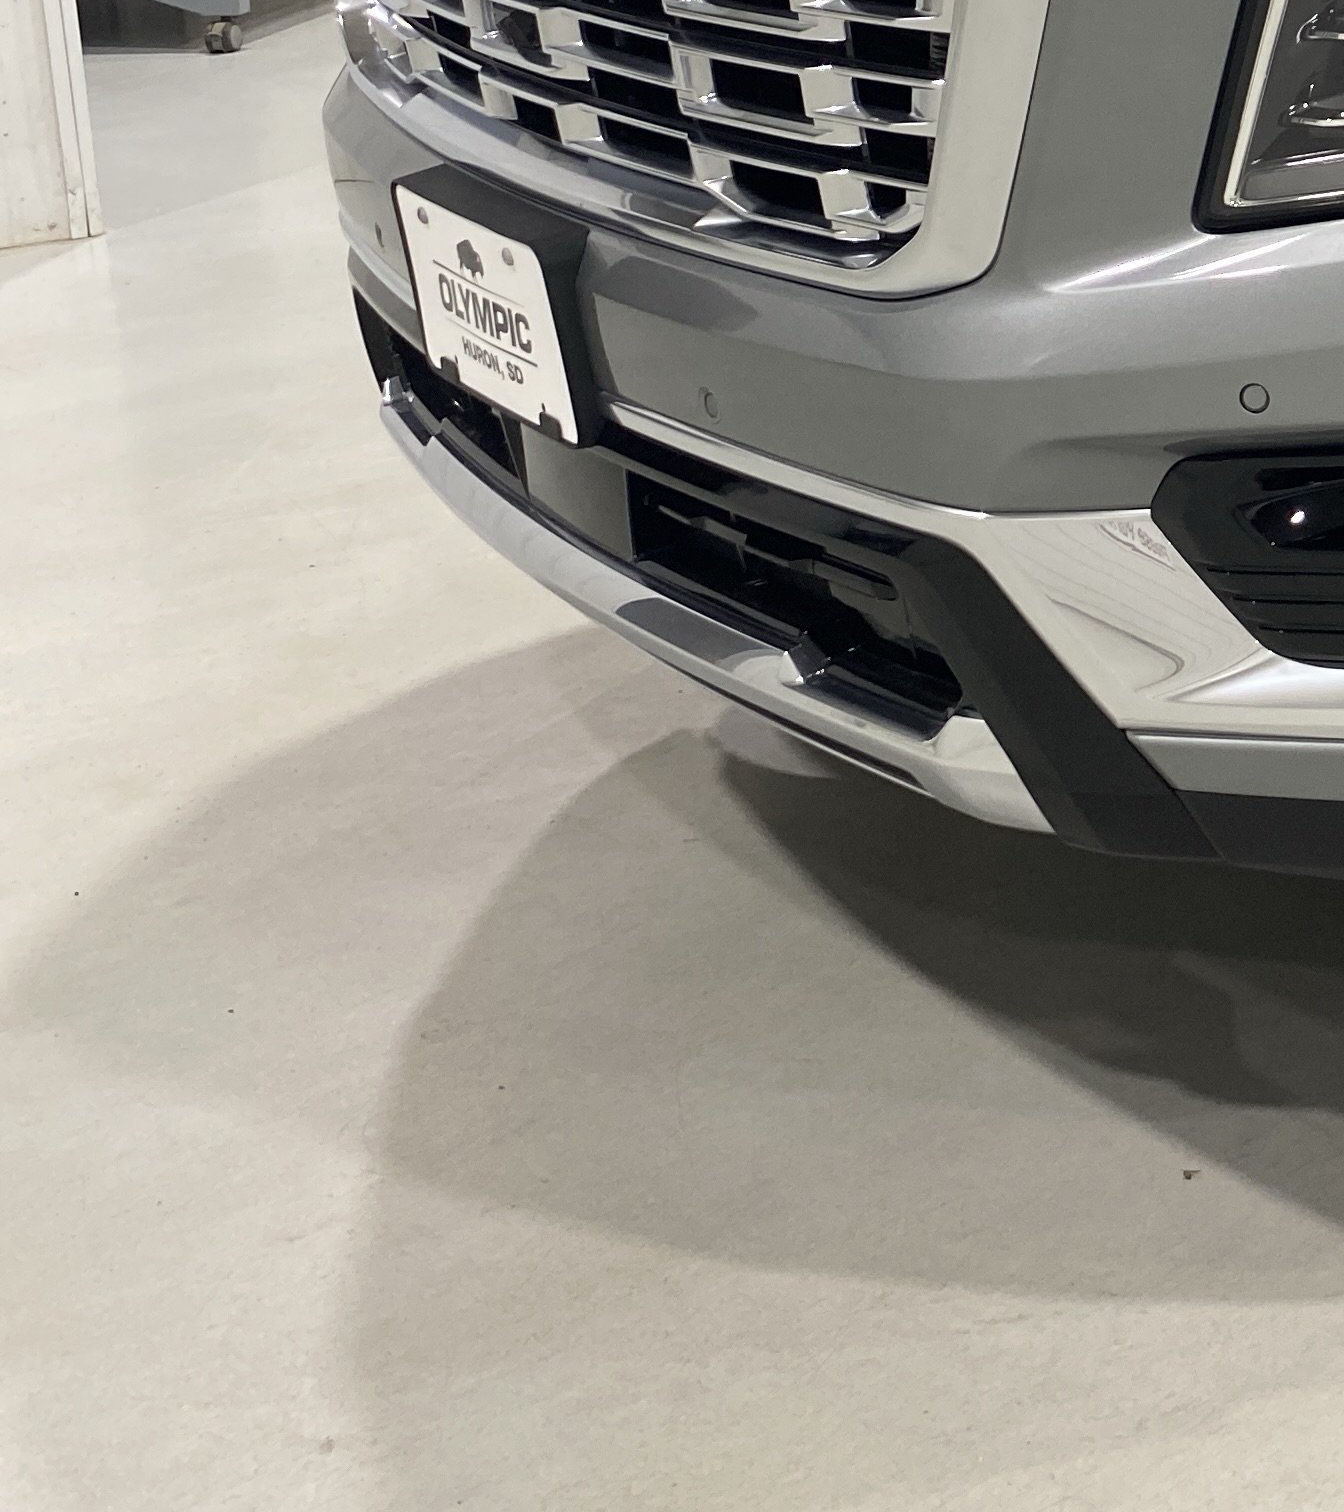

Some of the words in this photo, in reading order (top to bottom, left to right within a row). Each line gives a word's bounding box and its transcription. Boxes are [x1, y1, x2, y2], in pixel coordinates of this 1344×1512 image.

[438, 273, 533, 354] OLYMPIC
[462, 335, 505, 381] HURON,
[506, 360, 524, 385] SD
